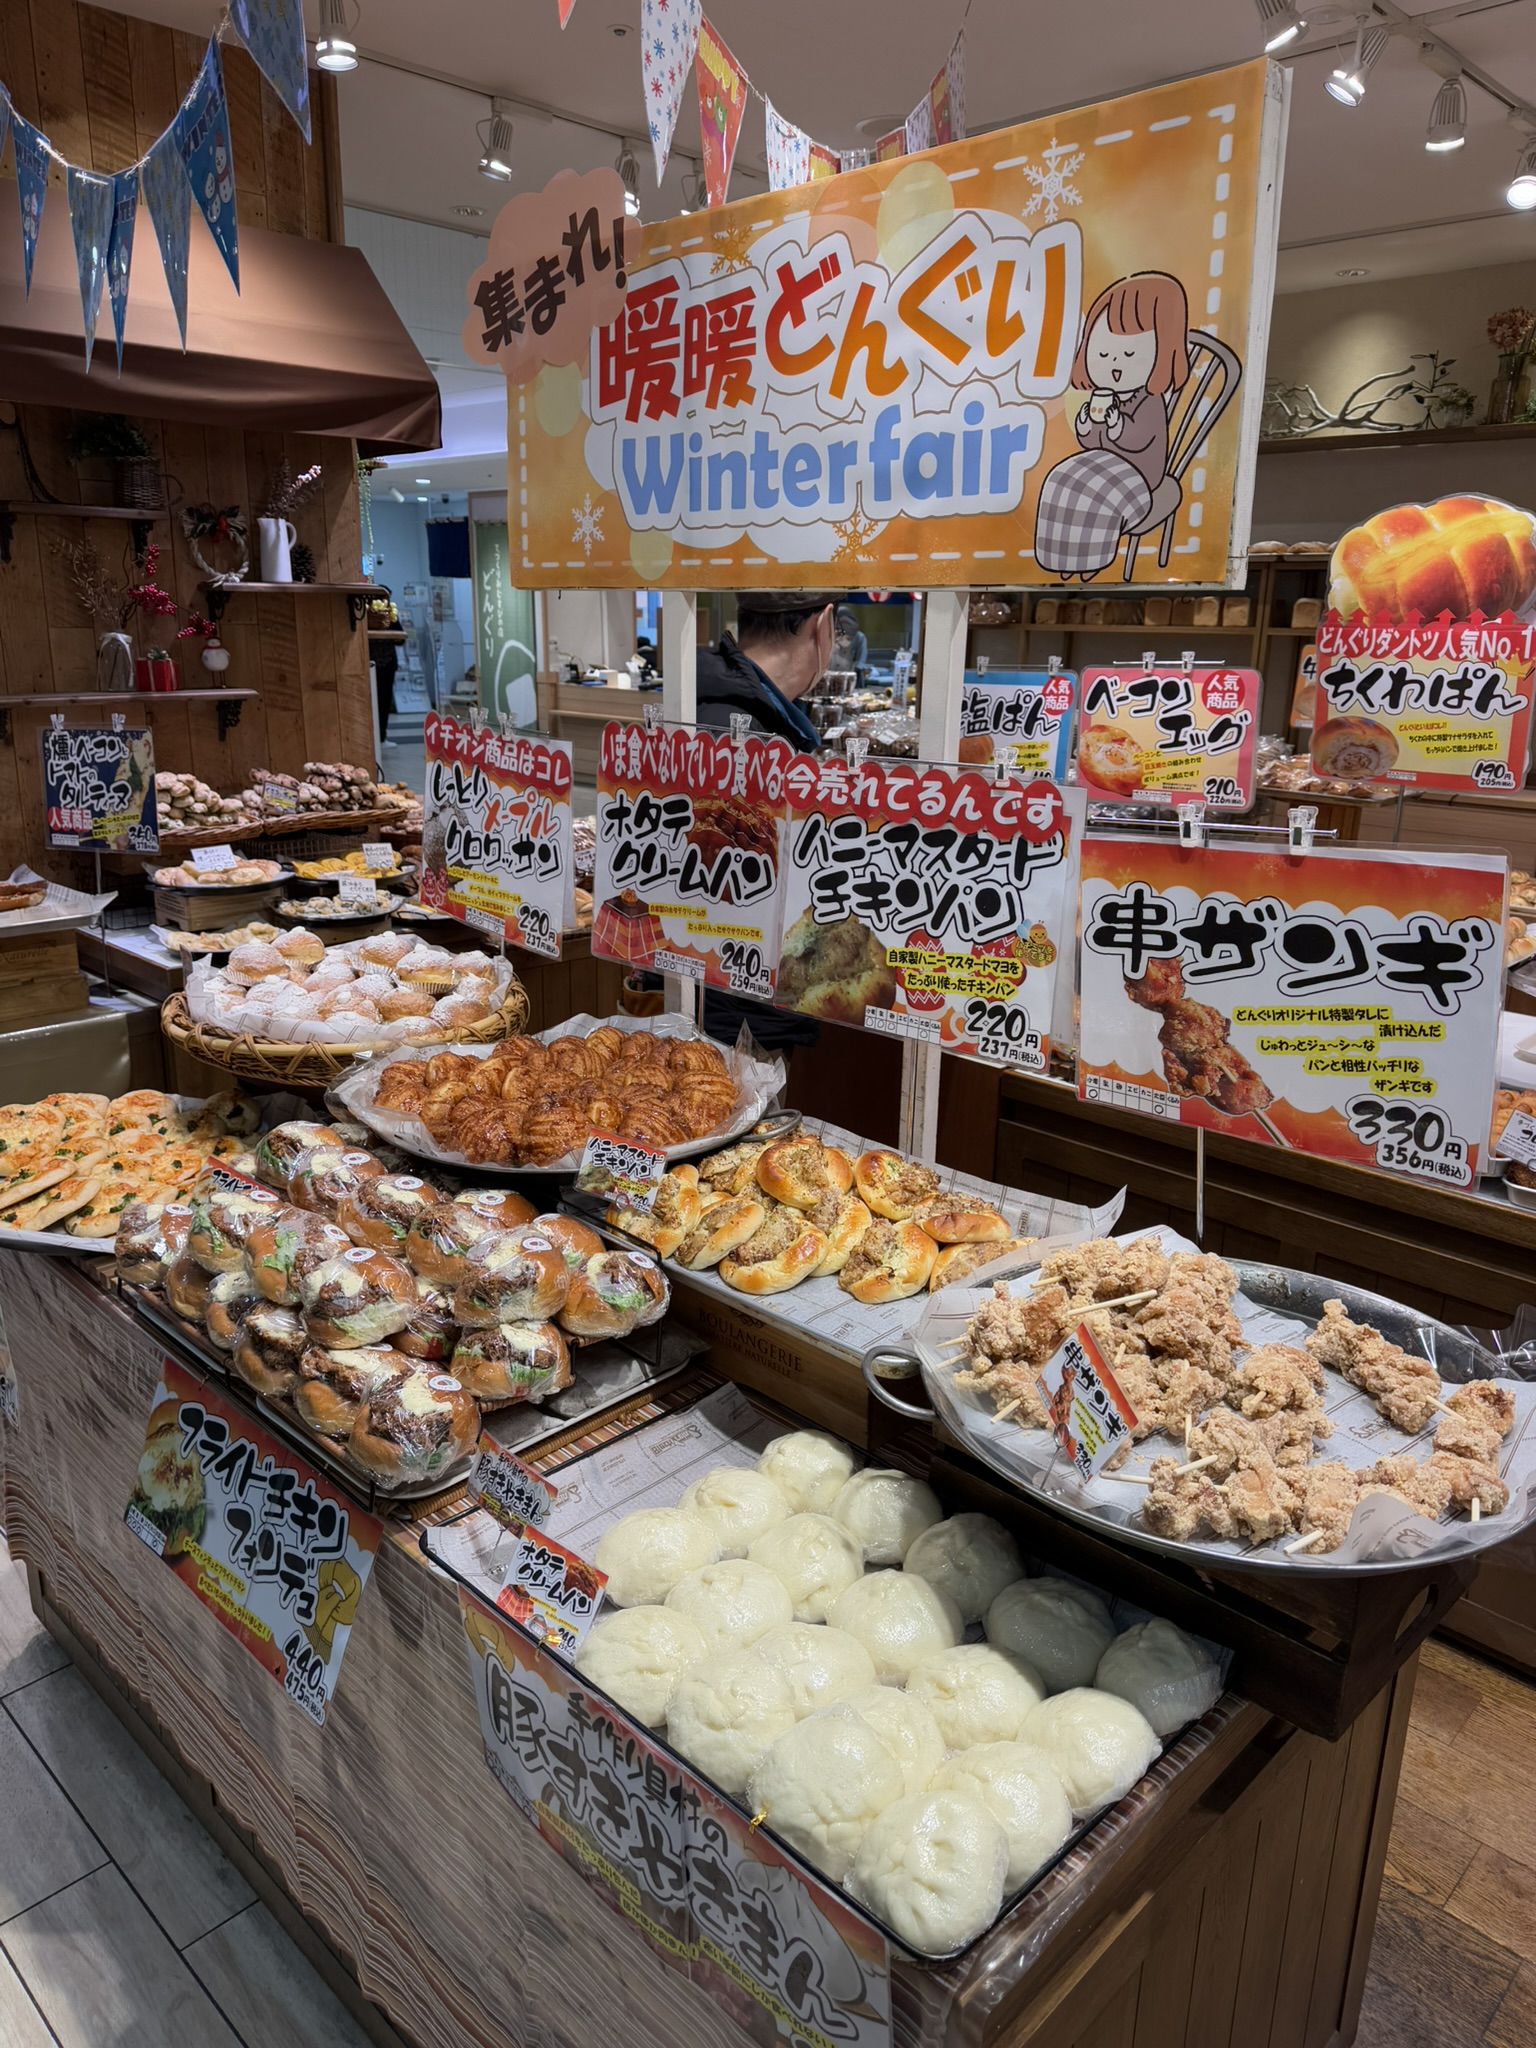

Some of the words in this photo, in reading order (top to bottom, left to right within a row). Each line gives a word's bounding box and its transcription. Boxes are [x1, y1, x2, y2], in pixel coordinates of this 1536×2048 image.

[473, 206, 628, 353] 集まれ!
[598, 234, 1066, 422] 暖暖どんぐり
[621, 430, 859, 515] Winter
[868, 401, 1031, 503] fair
[482, 567, 495, 658] どんぐり
[1044, 695, 1070, 711] 商品
[1046, 679, 1071, 695] 人気
[1087, 678, 1192, 715] ベーコン
[1206, 675, 1240, 692] 人気
[1206, 692, 1240, 709] 商品
[1324, 662, 1522, 715] ちくわぱん
[1159, 713, 1250, 750] エッグ
[49, 761, 96, 784] トマトの
[433, 761, 488, 808] しっとり
[601, 728, 785, 801] いま食べないでいつ食べる
[1205, 778, 1242, 797] 210円
[1474, 762, 1512, 781] 190円
[61, 782, 130, 809] タルティーヌ
[484, 791, 558, 838] メープル
[604, 794, 691, 844] ホタテ
[786, 765, 1062, 831] 今売れてるんです
[49, 807, 93, 832] 人気商品
[447, 820, 558, 877] クロワッサン
[612, 842, 773, 901] クリームパン
[798, 818, 1060, 881] ハニーマスタード
[519, 905, 556, 943] 220円
[814, 870, 1017, 937] チキンパン
[721, 941, 770, 982] 240円
[889, 950, 1020, 975] 自家製ハニーマスタードマヨを
[1093, 889, 1484, 1008] 串ザンギ
[730, 973, 773, 996] 259円(税込)
[907, 972, 1016, 996] たっぷり使ったチキンパン
[968, 1000, 1039, 1049] 220円
[1378, 1023, 1442, 1038] 漬け込んだ
[981, 1037, 1043, 1066] 237円(税込)
[1307, 1059, 1420, 1074] パンと相性バッチリな
[1374, 1079, 1434, 1094] ザンギです
[589, 1137, 664, 1165] ハニーマスタード
[1351, 1100, 1463, 1160] 330円
[594, 1152, 652, 1178] チキンパン
[1383, 1144, 1468, 1181] 356円(税込)
[700, 1307, 802, 1373] BOULANGERIE
[1064, 1340, 1129, 1442] 串ザンギ
[179, 1406, 346, 1555] フライドチキン
[226, 1506, 317, 1620] フォンデュ
[518, 1541, 566, 1574] ホタテ
[517, 1562, 592, 1614] クリームパン
[284, 1635, 327, 1702] 440円
[567, 1692, 729, 1857] 手作り具材の
[490, 1660, 850, 2029] 豚すきやきまん
